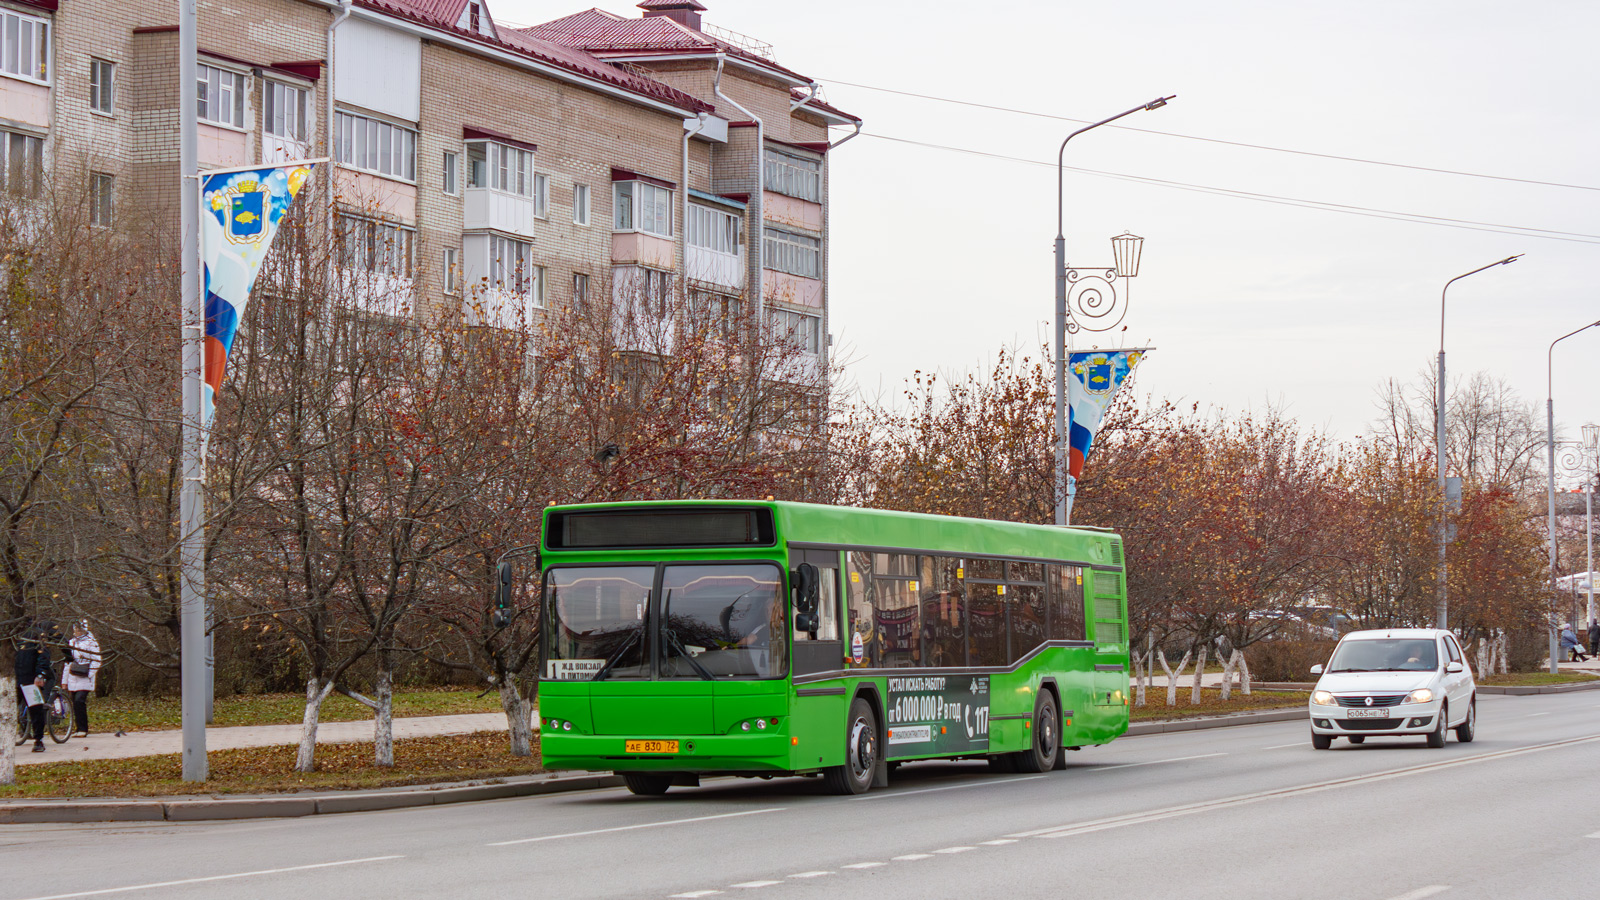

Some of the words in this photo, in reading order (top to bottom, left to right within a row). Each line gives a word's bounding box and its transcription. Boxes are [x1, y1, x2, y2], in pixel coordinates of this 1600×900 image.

[551, 662, 557, 679] 1
[575, 662, 602, 670] ВОКЗАЛ
[888, 678, 905, 693] УСТАЛ
[906, 677, 925, 692] ИСКАТЬ
[925, 676, 946, 691] РАБОТУ?
[888, 709, 895, 723] от
[895, 696, 902, 723] 6
[903, 695, 919, 722] 000
[920, 695, 936, 721] 000
[944, 703, 949, 720] в
[949, 702, 961, 723] год
[975, 706, 989, 735] 117
[630, 743, 641, 751] АЕ
[644, 742, 661, 751] 830
[666, 741, 675, 749] 72
